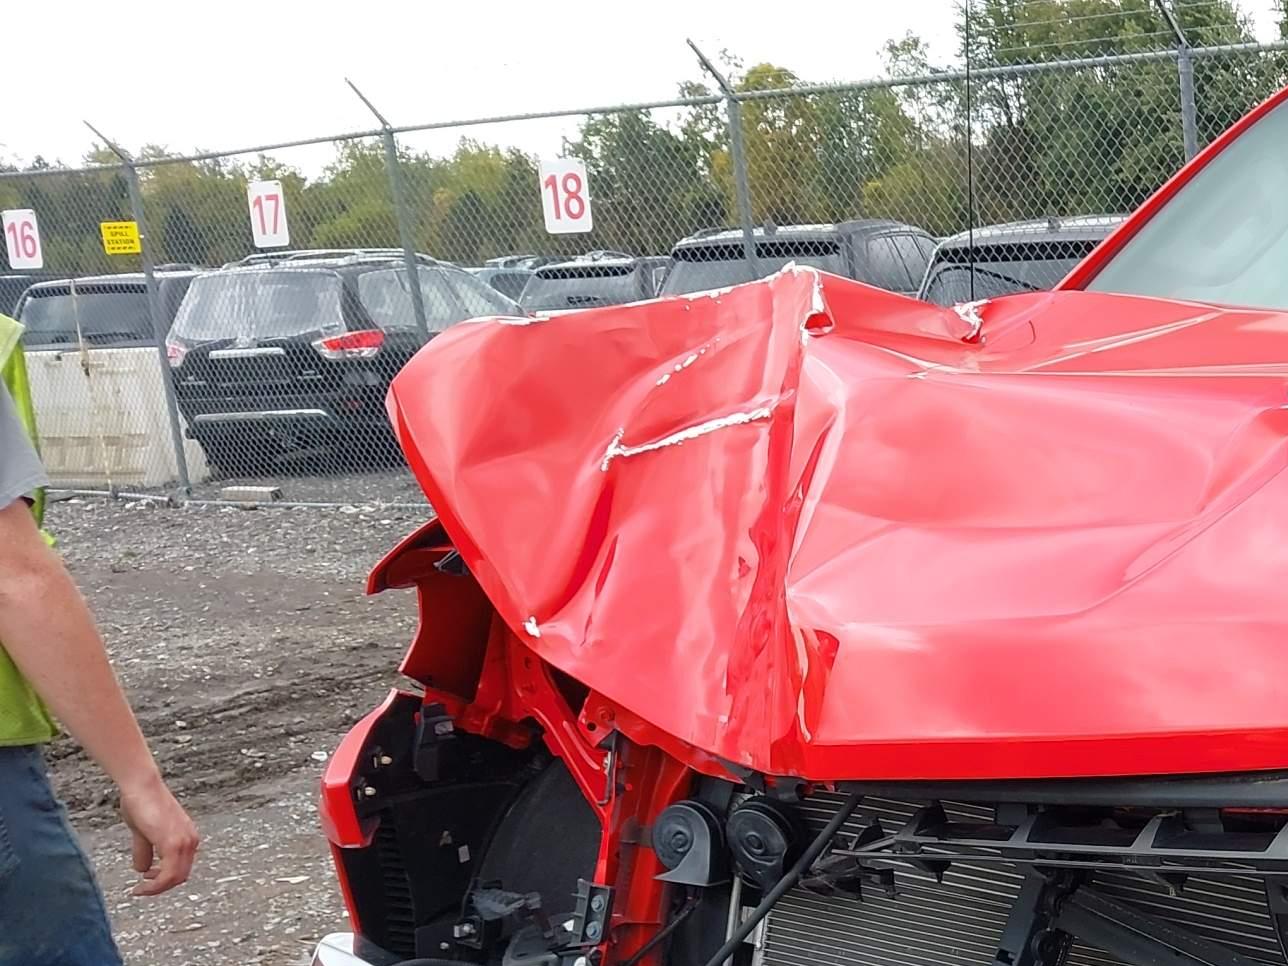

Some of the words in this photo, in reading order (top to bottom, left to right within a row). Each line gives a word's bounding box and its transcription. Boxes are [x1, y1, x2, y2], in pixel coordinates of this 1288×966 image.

[252, 194, 281, 236] 17
[544, 172, 586, 220] 18
[7, 220, 37, 258] 16
